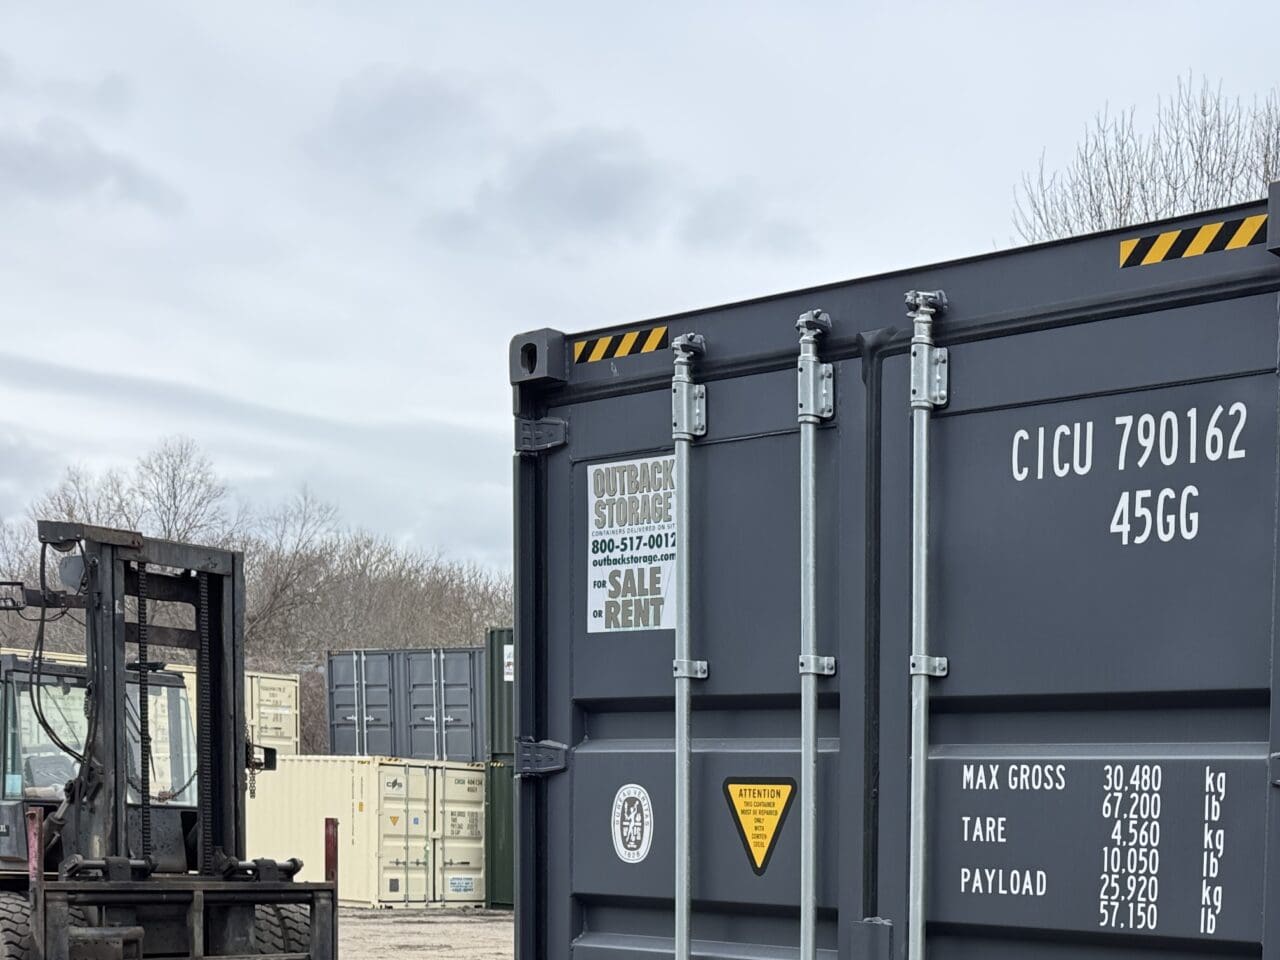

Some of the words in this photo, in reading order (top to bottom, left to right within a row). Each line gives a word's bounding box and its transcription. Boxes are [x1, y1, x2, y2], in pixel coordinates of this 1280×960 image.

[1011, 421, 1094, 481] CICU
[1114, 402, 1247, 471] 790162
[593, 459, 675, 498] OUTBACK
[594, 491, 673, 529] STORAGE
[1110, 484, 1199, 545] 45GG
[592, 532, 676, 555] 800-517-0012
[593, 580, 607, 589] FOR
[608, 566, 662, 599] SALE
[593, 610, 603, 619] OR
[604, 597, 665, 629] RENT
[739, 789, 781, 799] ATTENTION
[962, 764, 999, 790] MAX
[1008, 764, 1066, 790] GROSS
[1205, 766, 1226, 801] kg
[1204, 795, 1221, 821] lb
[962, 817, 1007, 842] TARE
[1203, 823, 1225, 858] kg
[1202, 851, 1218, 878] lb
[960, 868, 1047, 896] PAYLOAD
[1201, 880, 1222, 914] kg
[1199, 908, 1216, 934] lb
